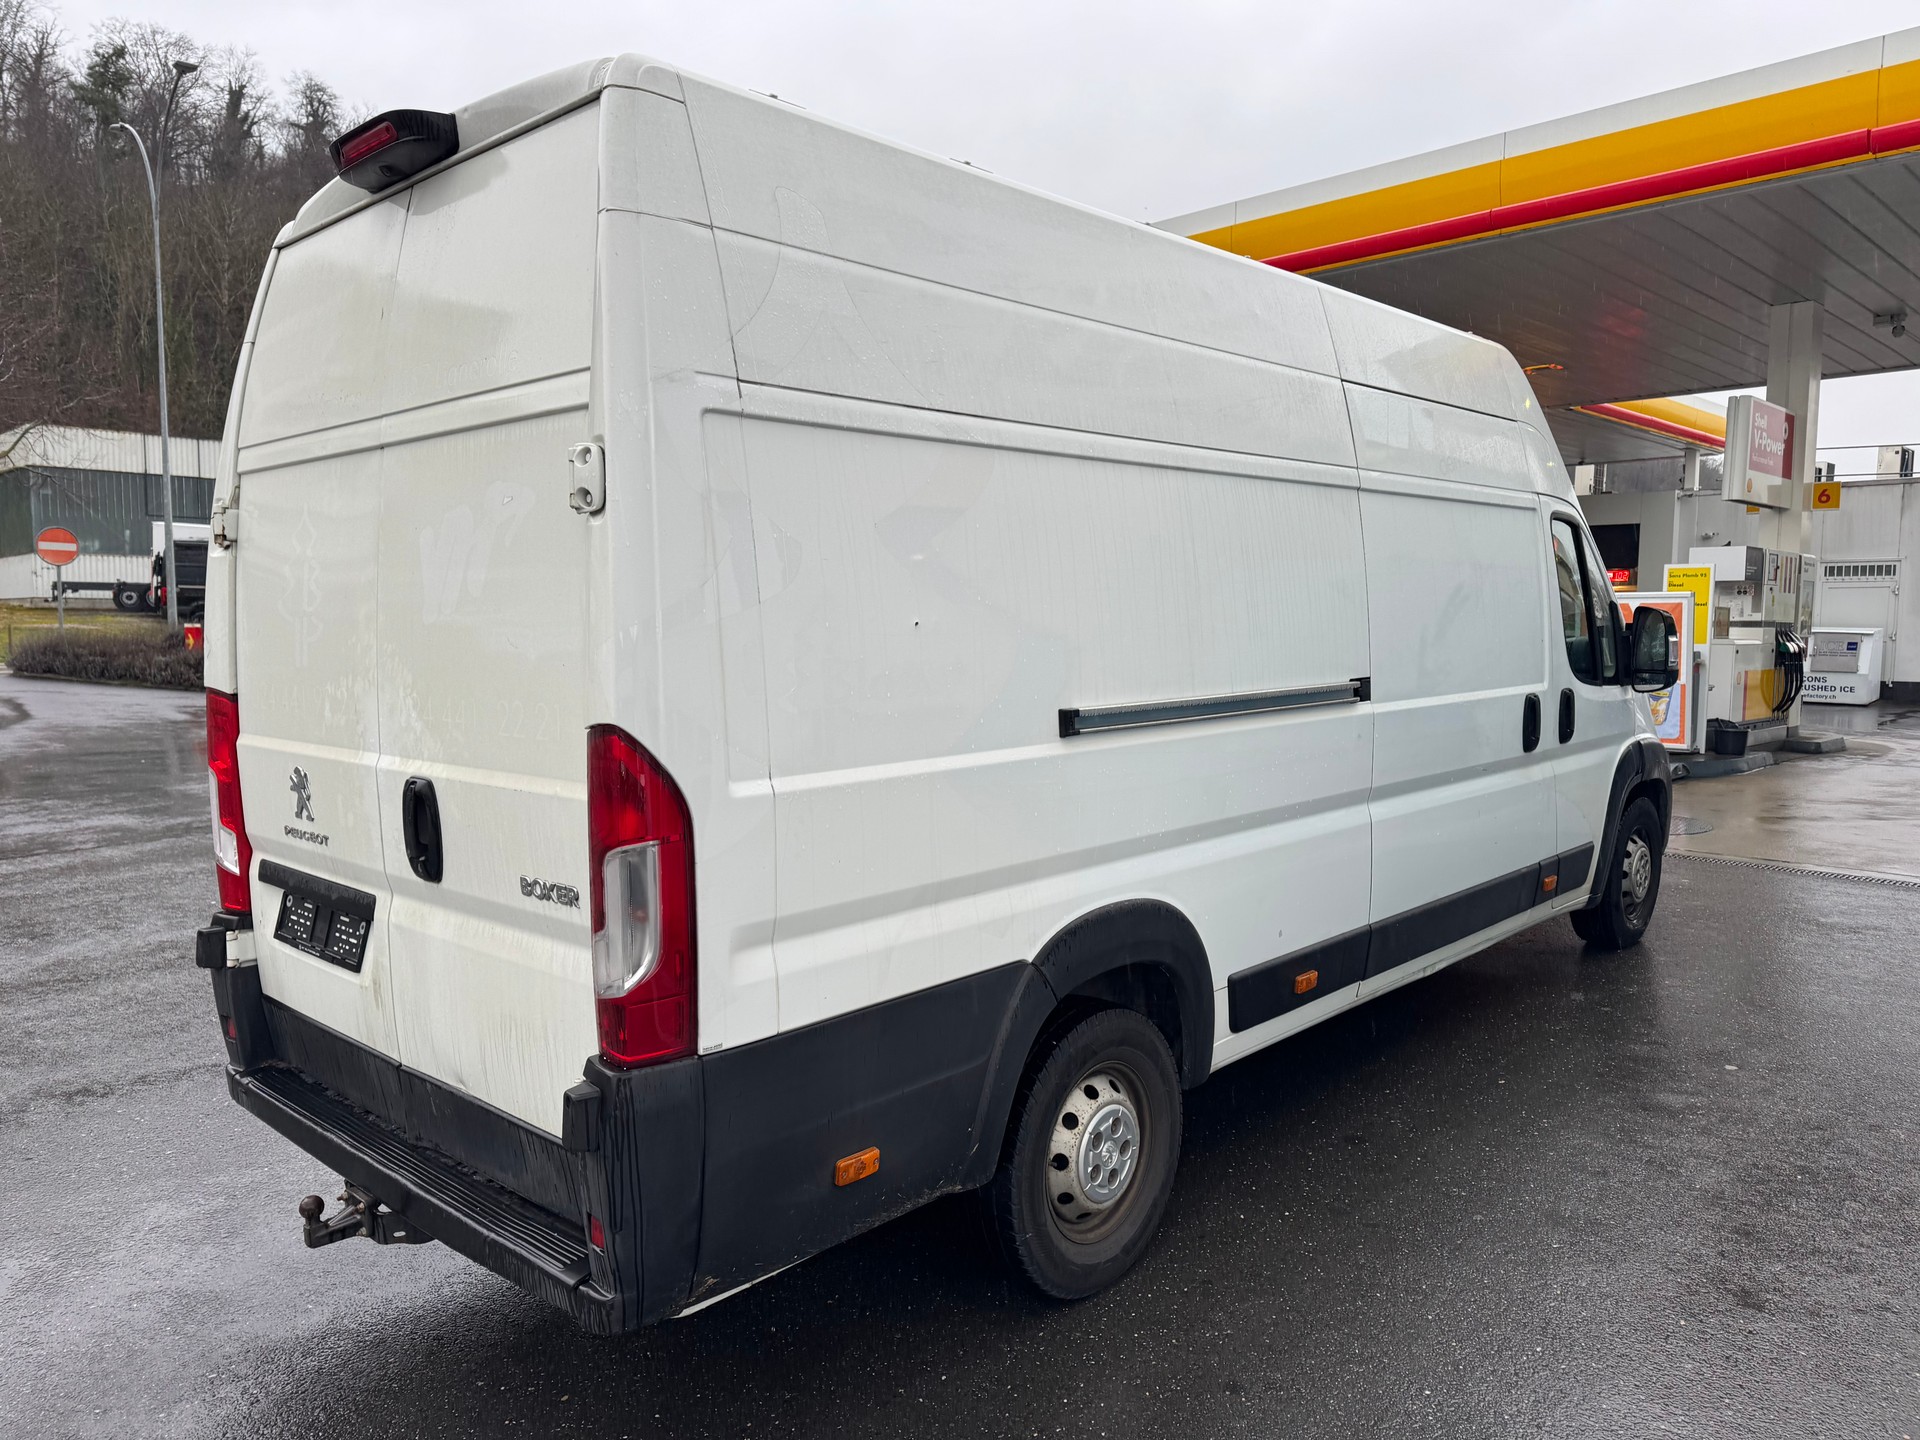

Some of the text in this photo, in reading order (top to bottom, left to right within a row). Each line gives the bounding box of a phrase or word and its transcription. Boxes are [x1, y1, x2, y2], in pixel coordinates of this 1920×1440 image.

[1754, 413, 1768, 429] Shell
[1817, 488, 1831, 504] 6
[1802, 684, 1837, 692] USHED
[284, 824, 330, 847] PEUGEOT
[519, 874, 581, 909] BOXER
